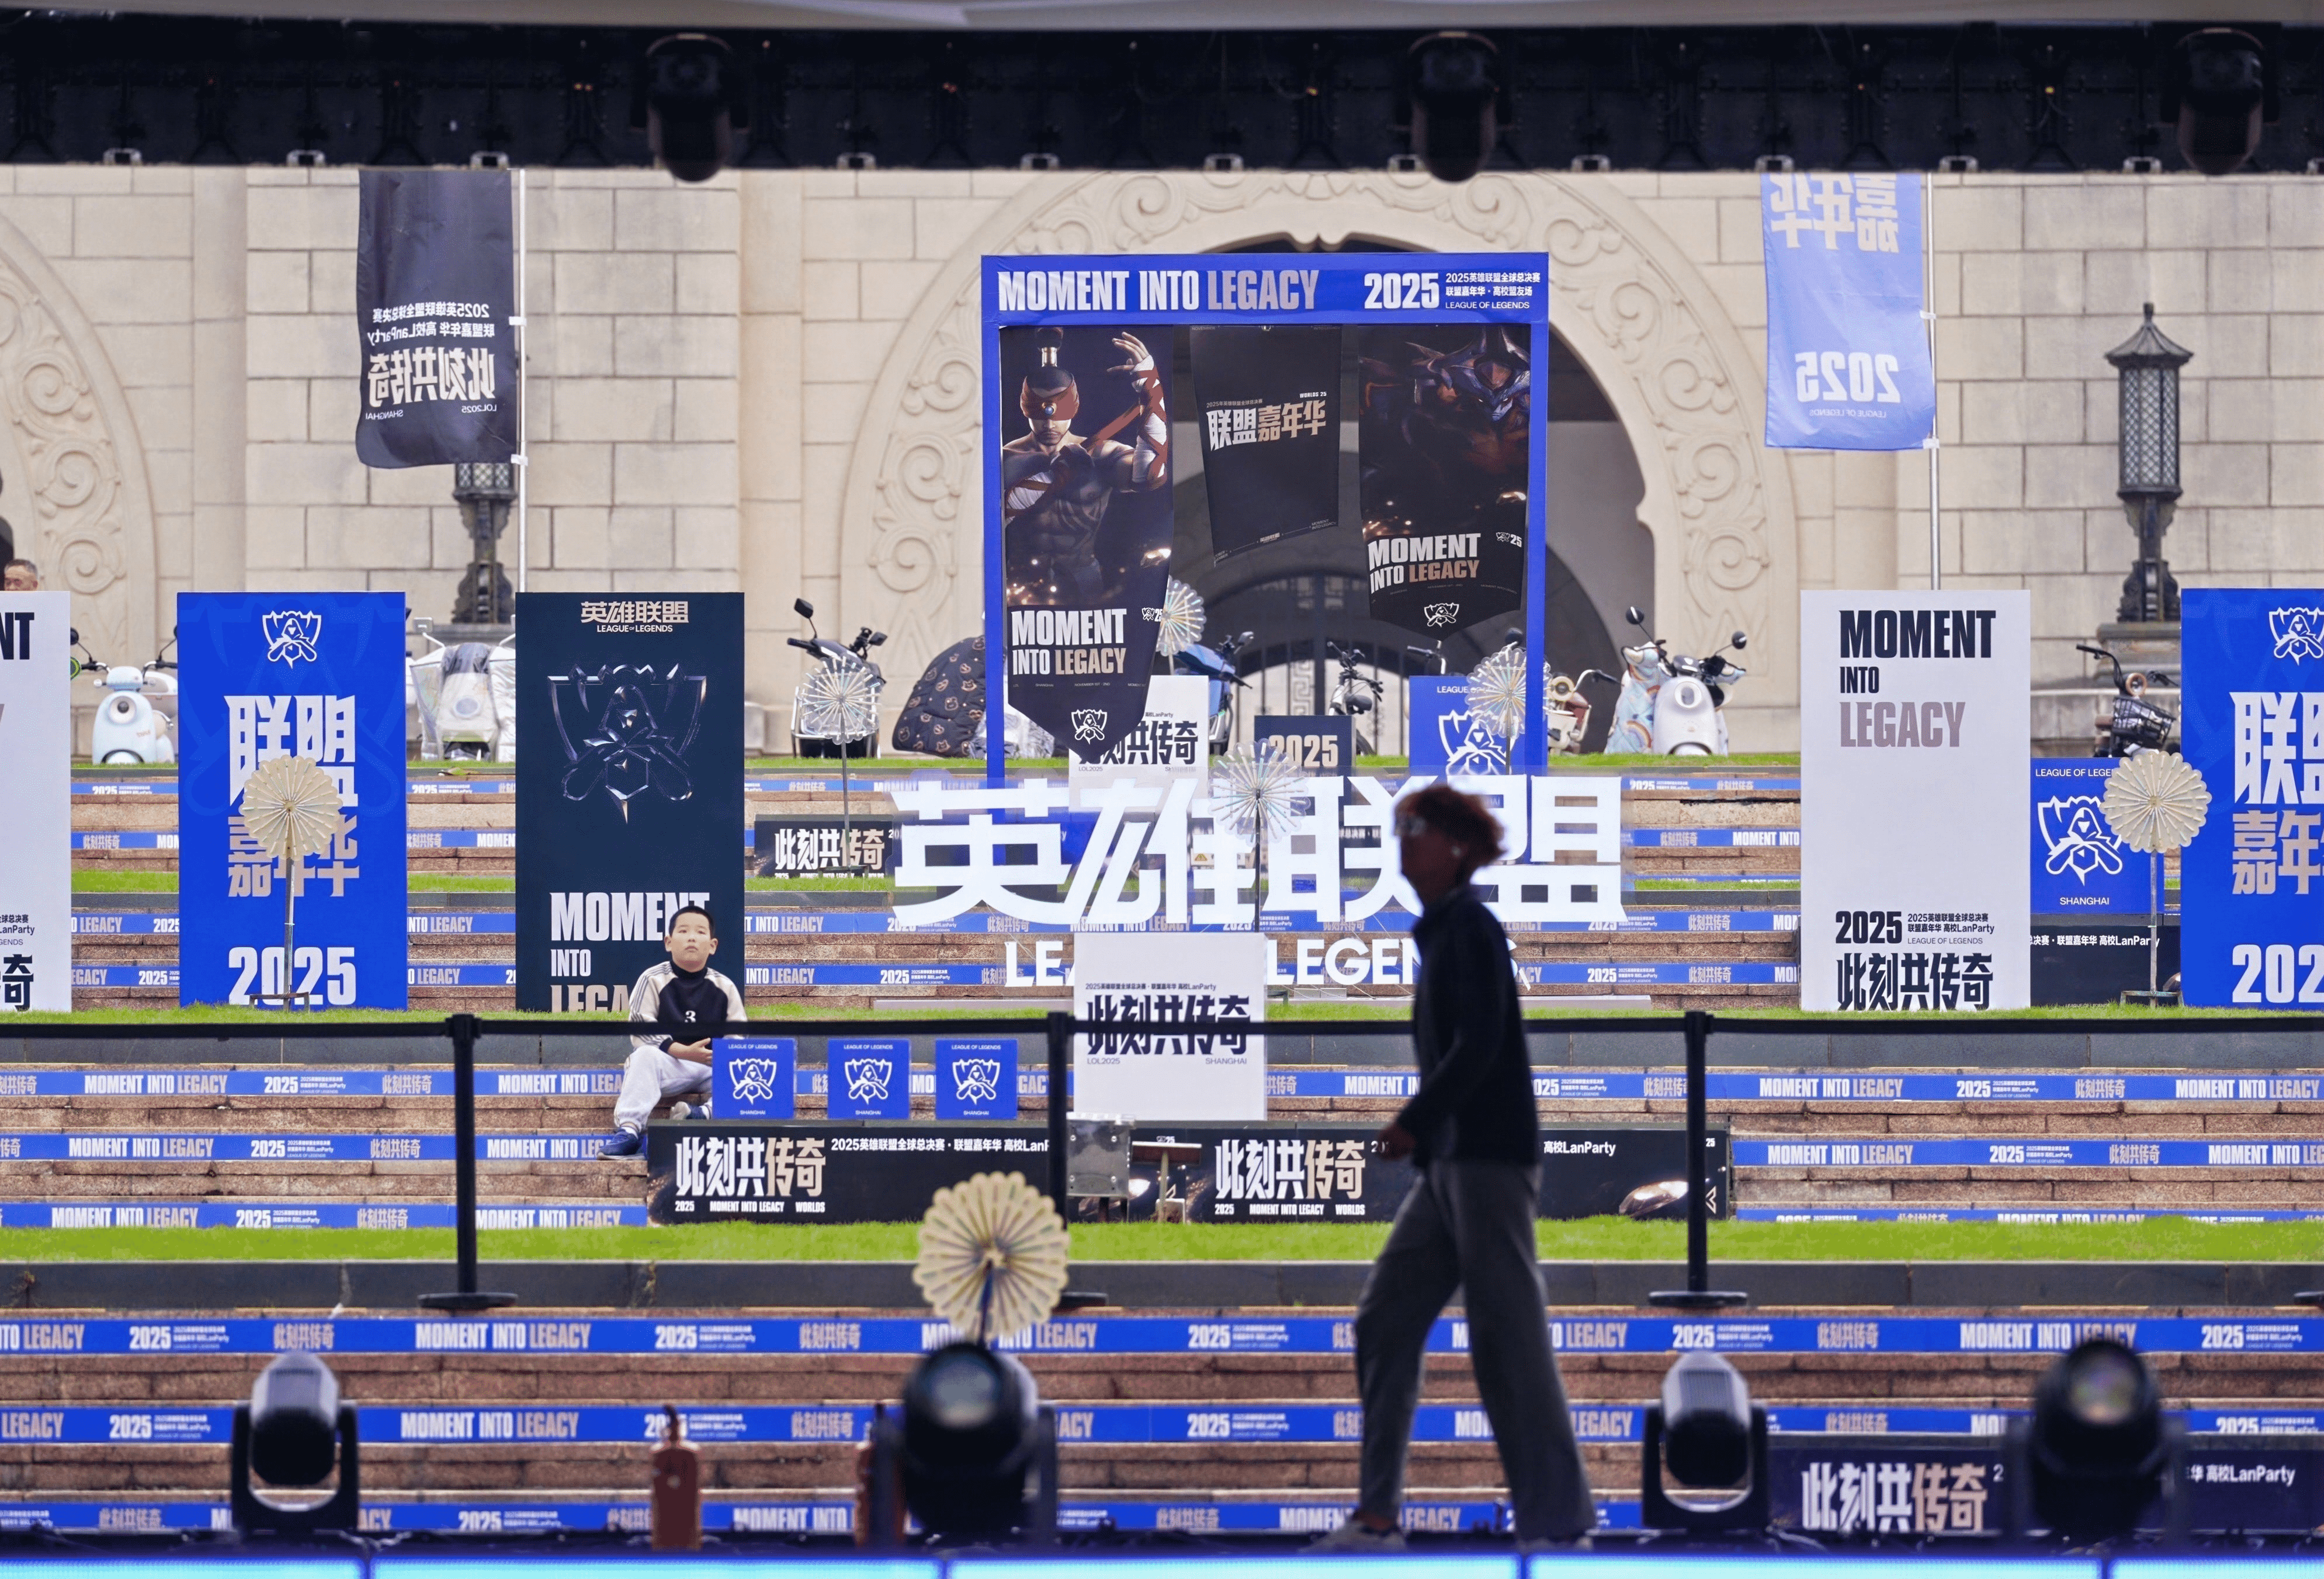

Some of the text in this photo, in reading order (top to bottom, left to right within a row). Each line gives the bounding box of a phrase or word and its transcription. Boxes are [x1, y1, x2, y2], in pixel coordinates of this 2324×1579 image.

[1446, 272, 1540, 283] 2025英雄联盟全球总决赛
[998, 270, 1319, 311] MOMENT INTO LEGACY
[1364, 273, 1440, 309] 2025
[1206, 400, 1326, 452] 联盟嘉年华
[1368, 533, 1481, 571] MOMENT
[1511, 534, 1522, 548] 25
[1370, 560, 1479, 594] INTO LEGACY
[581, 601, 689, 624] 英雄联盟
[1011, 608, 1127, 646] MOMENT
[1839, 610, 1996, 658] MOMENT
[1012, 648, 1126, 675] INTO LEGACY
[1840, 666, 1879, 693] INTO
[1840, 702, 1966, 747] LEGACY
[224, 695, 358, 807] 联盟
[1078, 721, 1198, 764] 共传奇
[2089, 768, 2113, 777] LEGE
[775, 829, 884, 870] 此刻共传奇
[890, 774, 1628, 926] 英雄联盟
[2232, 810, 2324, 895] 嘉年
[2060, 897, 2110, 905] SHANGHAI
[0, 915, 28, 923] 球总决赛
[80, 917, 122, 932] LEGACY
[756, 916, 824, 932] INTO LEGACY
[1688, 915, 1730, 930] 此刻共传奇
[1836, 911, 1902, 944] 2025
[1908, 913, 1988, 922] 2025英雄联盟全球总决赛
[1908, 924, 1995, 934] 联盟嘉年华 高校LanParty
[2100, 936, 2160, 947] 高校LanPary
[550, 949, 591, 977] INTO
[2232, 944, 2324, 1003] 202
[138, 971, 167, 985] 2025
[228, 947, 356, 1005] 2025
[880, 970, 909, 984] 2025
[1588, 969, 1616, 982] 2025
[1836, 953, 1993, 1011] 此刻共传奇
[550, 985, 630, 1012] LEGA
[685, 1010, 696, 1023] 3
[1087, 995, 1250, 1054] 此刻共传奇
[85, 1075, 227, 1093] MOMENT INTO LEGACY
[1344, 1076, 1403, 1095] MOMENT
[2176, 1079, 2320, 1098] MOMENT INTO LEGACY
[487, 1139, 577, 1158] MOMENT INTO
[1004, 1138, 1049, 1152] 高校LanP
[1543, 1141, 1616, 1156] 高校LanParty
[1706, 1138, 1715, 1147] 25
[675, 1137, 825, 1197] 此刻共传奇
[1215, 1140, 1365, 1200] 此刻共传奇
[675, 1201, 825, 1212] 2025 MOMENT INTO LEGACY WORLDS
[1215, 1204, 1365, 1215] 2025 MOMENT INTO LEGACY WORLDS
[24, 1325, 84, 1349] LEGACY
[416, 1324, 591, 1349] MOMENT INTO LEGACY
[1188, 1325, 1230, 1348] 2025
[1566, 1323, 1628, 1348] LEGACY
[2202, 1325, 2243, 1349] 2025
[2, 1412, 63, 1438] LEGACY
[110, 1415, 151, 1438] 2025
[401, 1412, 578, 1438] MOMENT INTO LEGACY
[1187, 1414, 1230, 1437] 2025
[1802, 1463, 1987, 1533] 此刻共传奇
